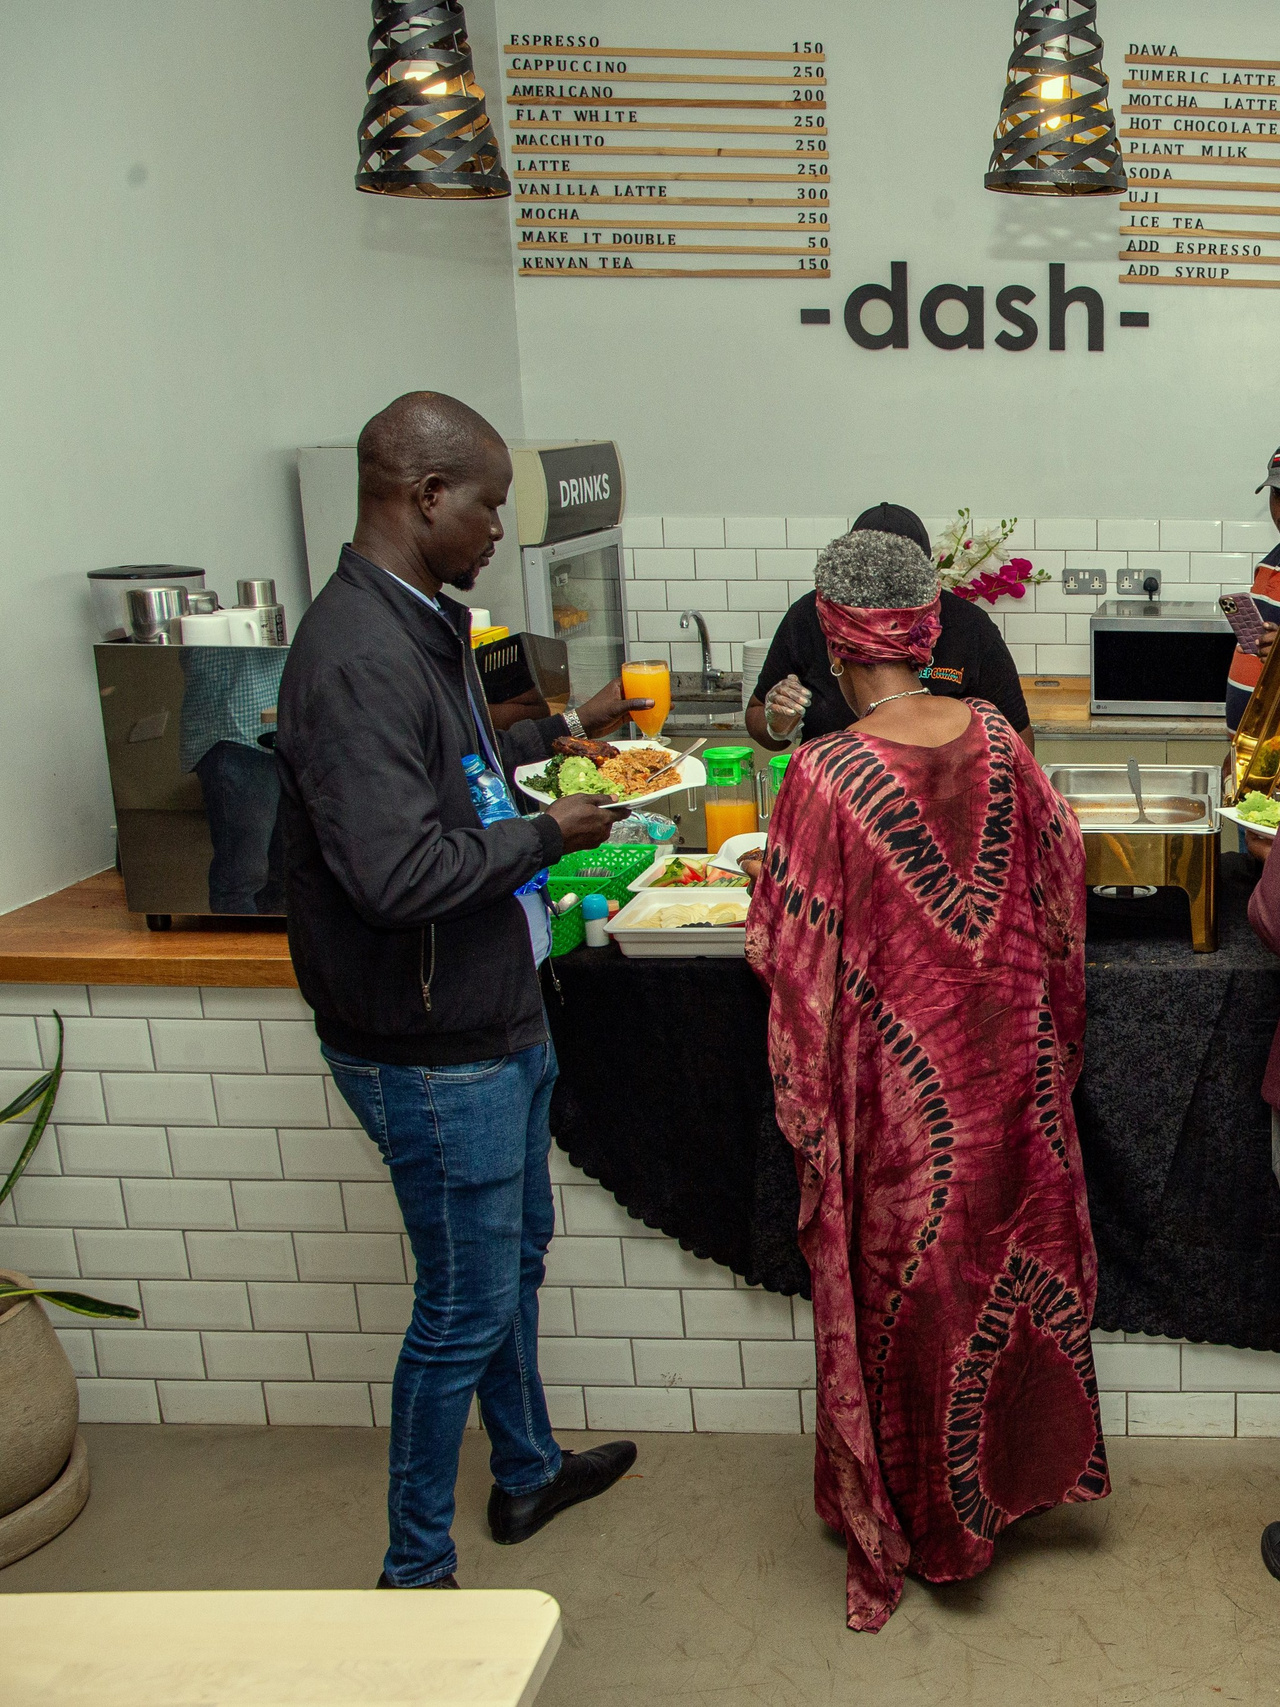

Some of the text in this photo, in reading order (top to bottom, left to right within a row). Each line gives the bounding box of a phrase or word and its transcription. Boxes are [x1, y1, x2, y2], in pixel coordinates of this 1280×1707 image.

[510, 35, 822, 54] ESPRESSO 150
[1129, 44, 1178, 57] DAWA
[512, 59, 824, 78] CAPPUCCINO 250
[1128, 70, 1208, 84] TUMERIC
[1223, 73, 1275, 87] LATTE
[512, 85, 825, 102] AMERICANO 200
[1128, 94, 1197, 108] MOTCHA
[1224, 98, 1276, 112] LATTE
[516, 109, 824, 128] FLAT WHITE 250
[1129, 118, 1161, 131] HOT
[1174, 120, 1277, 135] CHOCOLATE
[516, 135, 826, 152] MACCHITO 250
[1130, 143, 1184, 155] PLANT
[1201, 146, 1246, 158] MILK
[517, 160, 827, 176] LATTE 250
[1129, 168, 1171, 180] SODA
[519, 184, 827, 200] VANILLA LATTE 300
[1128, 191, 1158, 204] UJI
[521, 208, 827, 224] MOCHA 250
[1130, 216, 1159, 228] ICE
[1173, 218, 1203, 230] TEA
[522, 231, 828, 249] MAKE IT DOUBLE 50
[1126, 240, 1158, 253] ADD
[523, 257, 828, 270] KENYAN TEA 150
[1127, 265, 1159, 277] ADD
[1175, 267, 1228, 279] SYRUP
[559, 473, 610, 508] DRINKS
